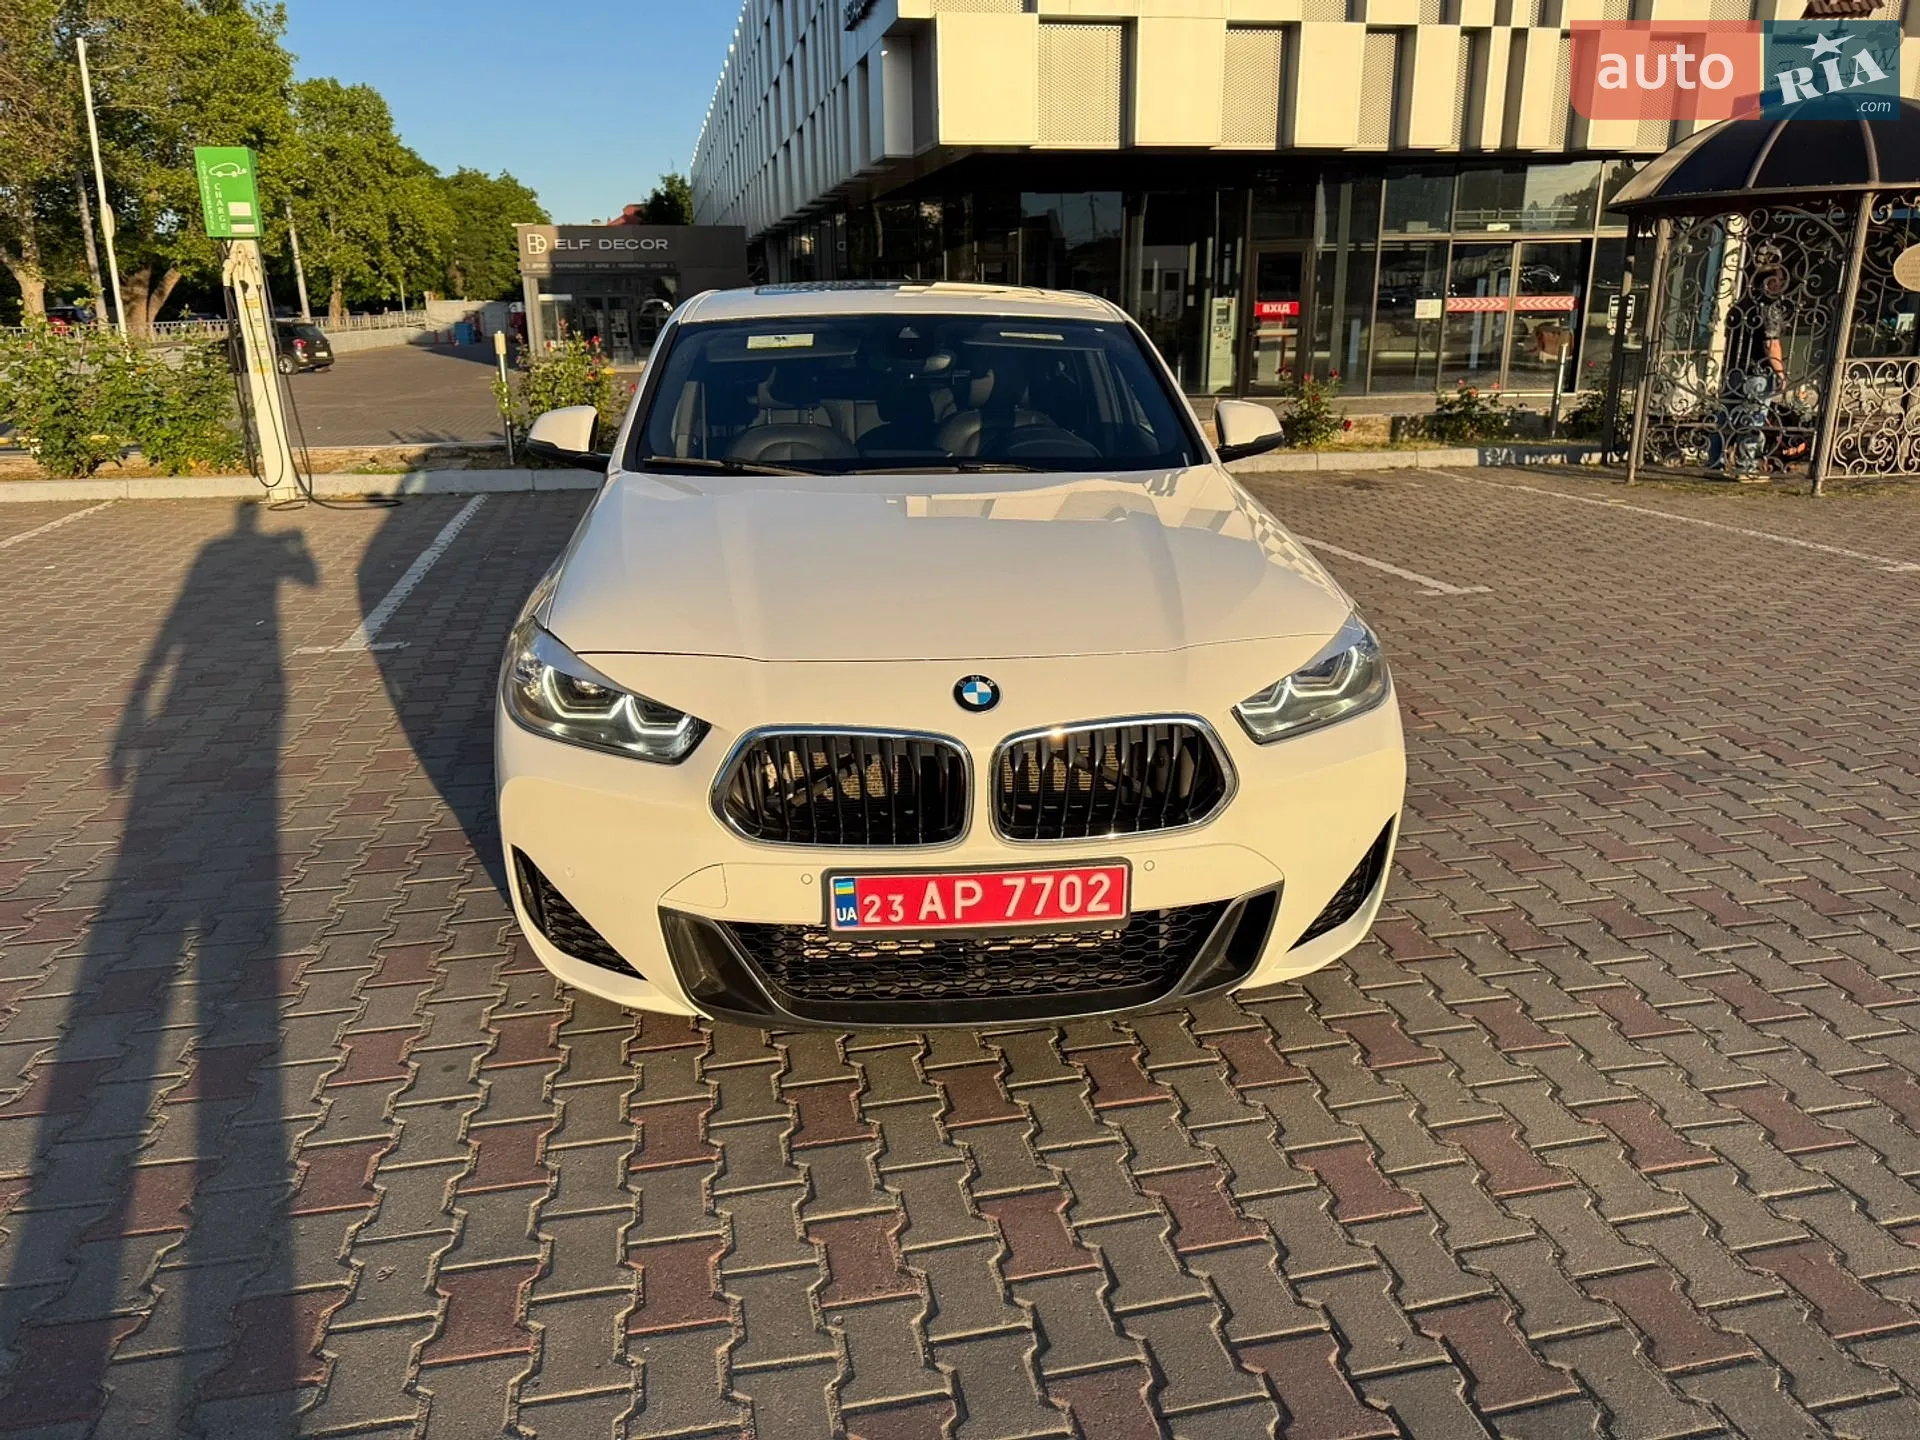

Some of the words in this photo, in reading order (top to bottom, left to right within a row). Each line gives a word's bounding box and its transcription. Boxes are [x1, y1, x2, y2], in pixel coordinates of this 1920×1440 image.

[213, 183, 227, 231] CHARGE
[554, 238, 592, 250] ELF
[598, 238, 669, 250] DECOR
[863, 894, 904, 923] 23
[918, 880, 984, 921] AP
[1002, 872, 1111, 918] 7702
[836, 906, 858, 922] UA
